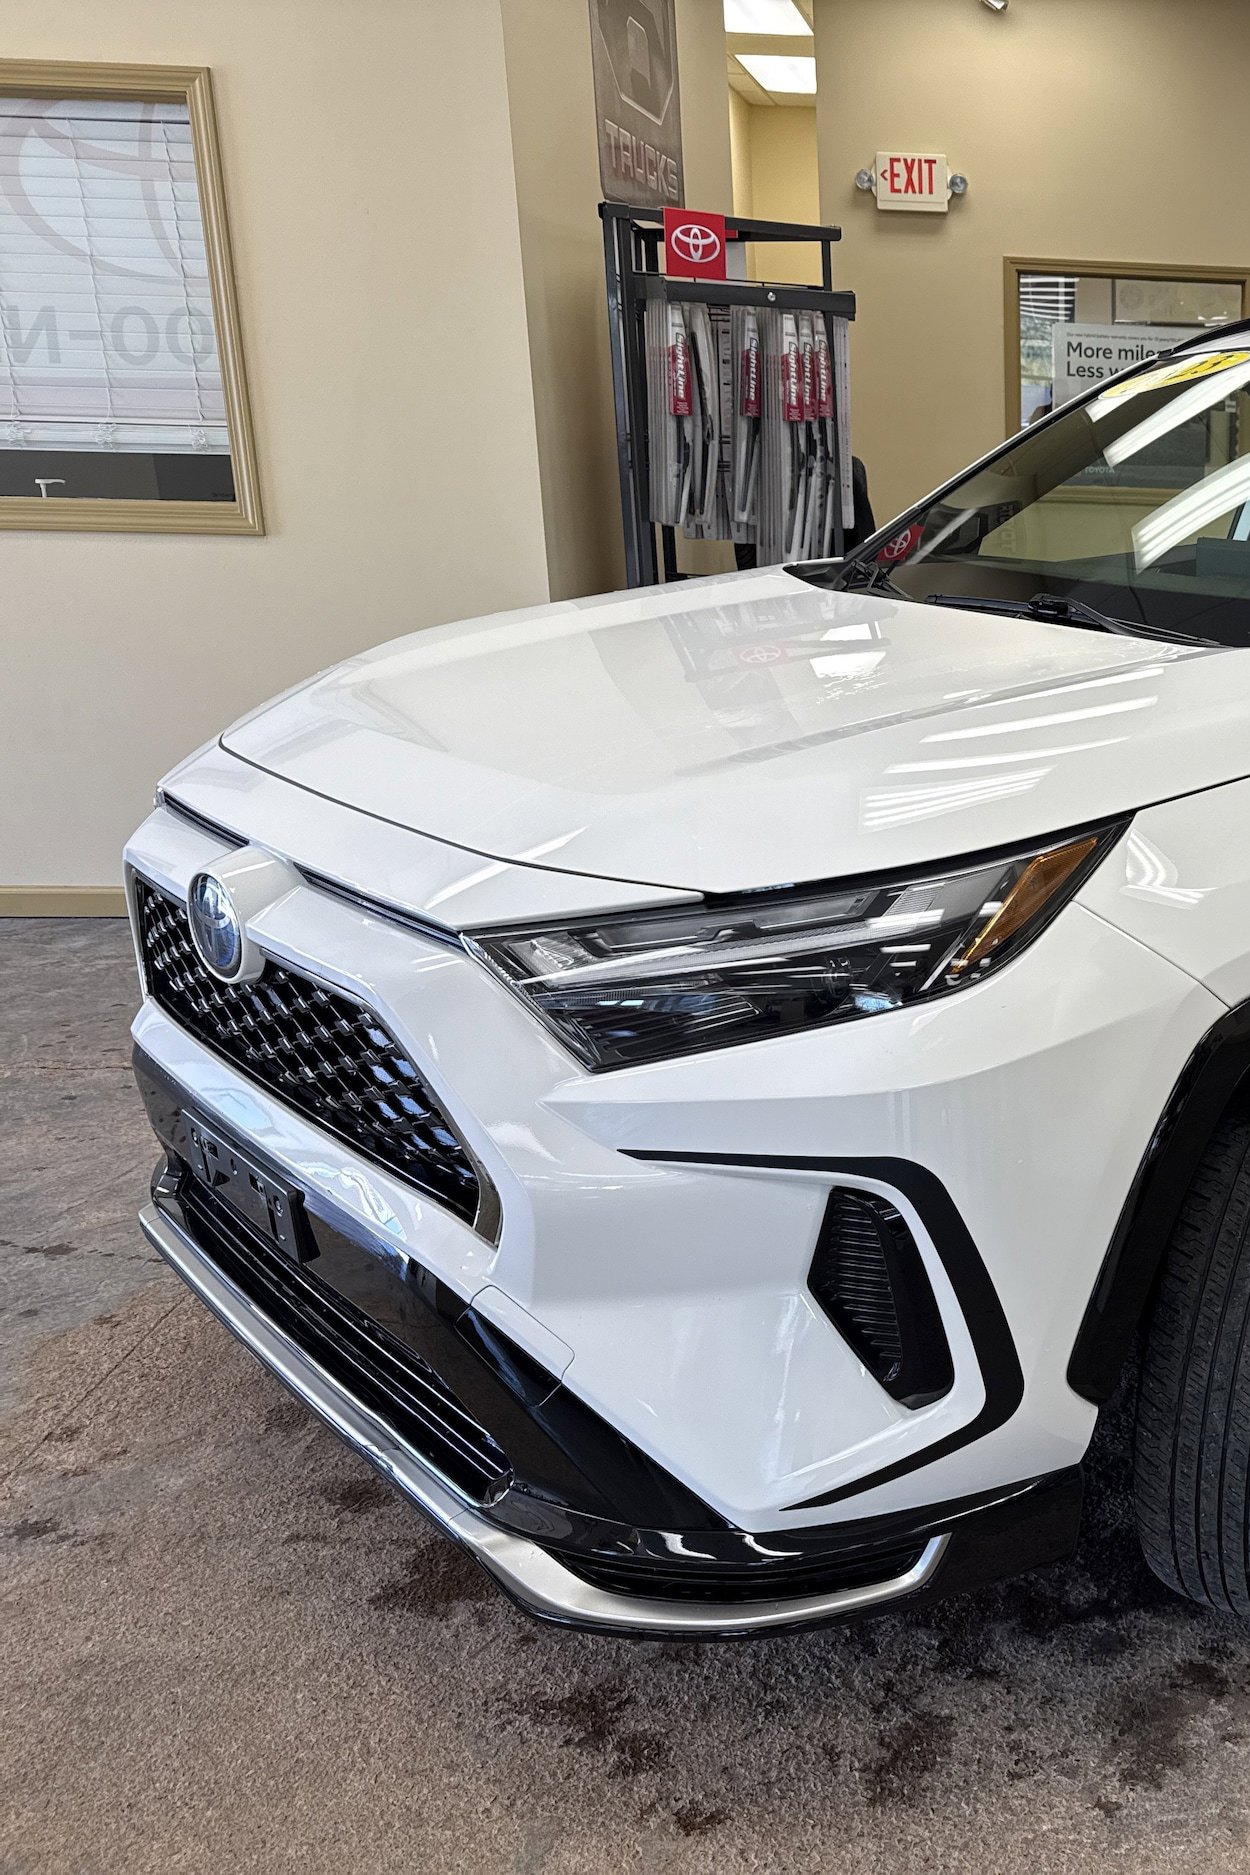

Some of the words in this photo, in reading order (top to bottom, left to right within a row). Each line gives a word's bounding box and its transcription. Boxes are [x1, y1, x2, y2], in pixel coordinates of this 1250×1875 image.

[604, 119, 679, 200] TRUCKS
[889, 157, 937, 195] EXIT
[1067, 341, 1113, 360] More
[1118, 344, 1160, 361] mile
[1067, 360, 1104, 378] Less
